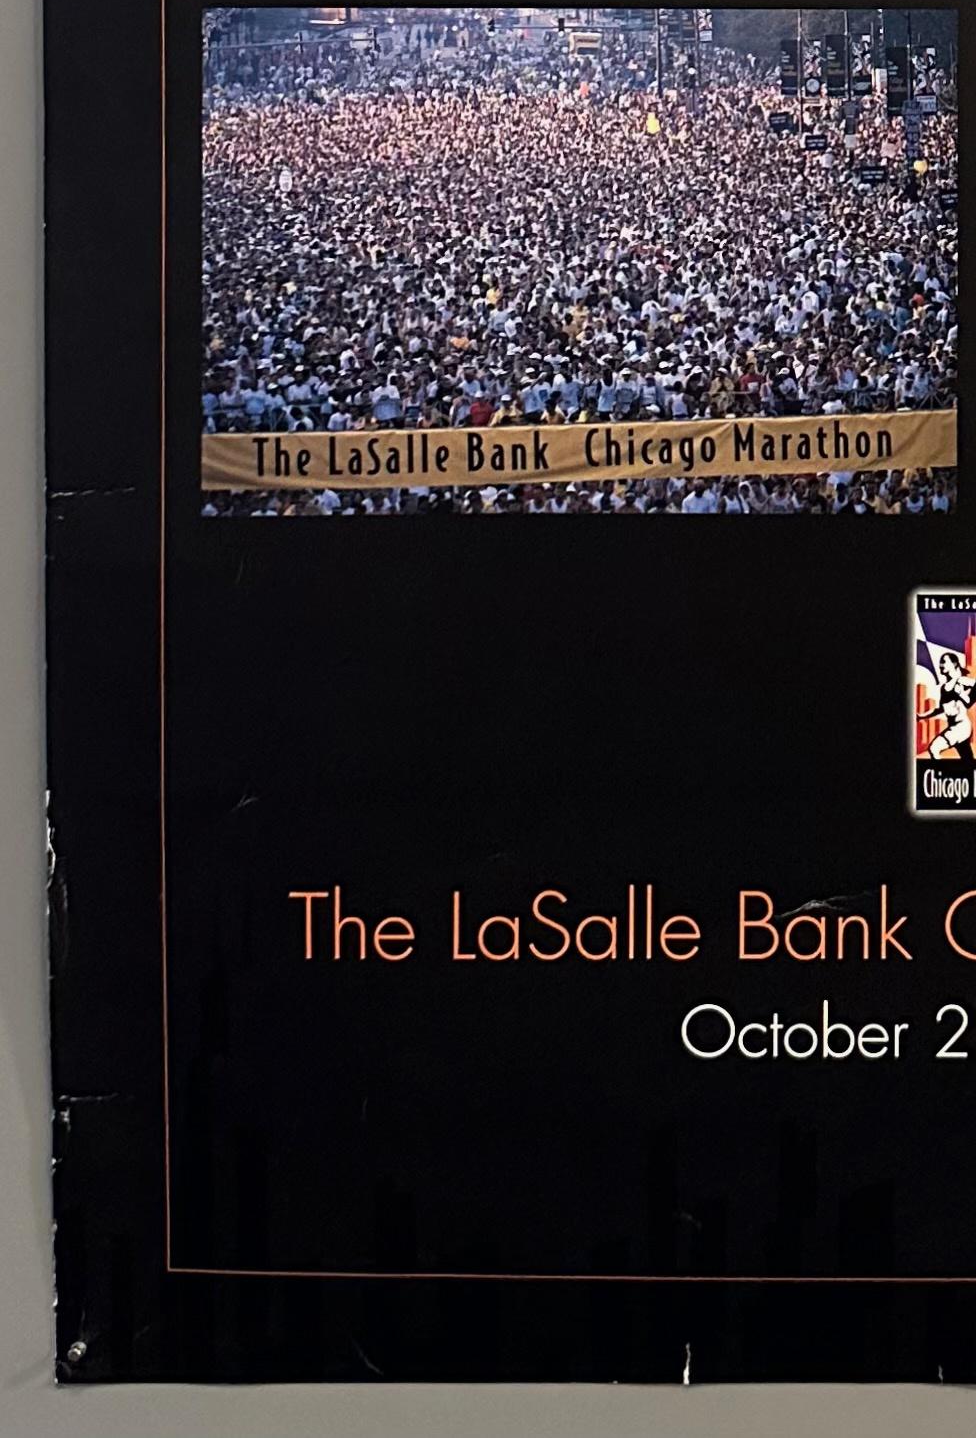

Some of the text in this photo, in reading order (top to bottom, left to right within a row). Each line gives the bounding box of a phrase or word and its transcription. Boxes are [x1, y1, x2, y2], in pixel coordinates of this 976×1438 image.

[252, 420, 893, 477] The LaSalle Bank Chicago Marathon
[924, 597, 944, 610] The
[923, 768, 970, 804] Chicago
[288, 884, 415, 961] The
[452, 884, 701, 961] LaSalle
[738, 884, 913, 961] Bank
[681, 999, 909, 1060] October
